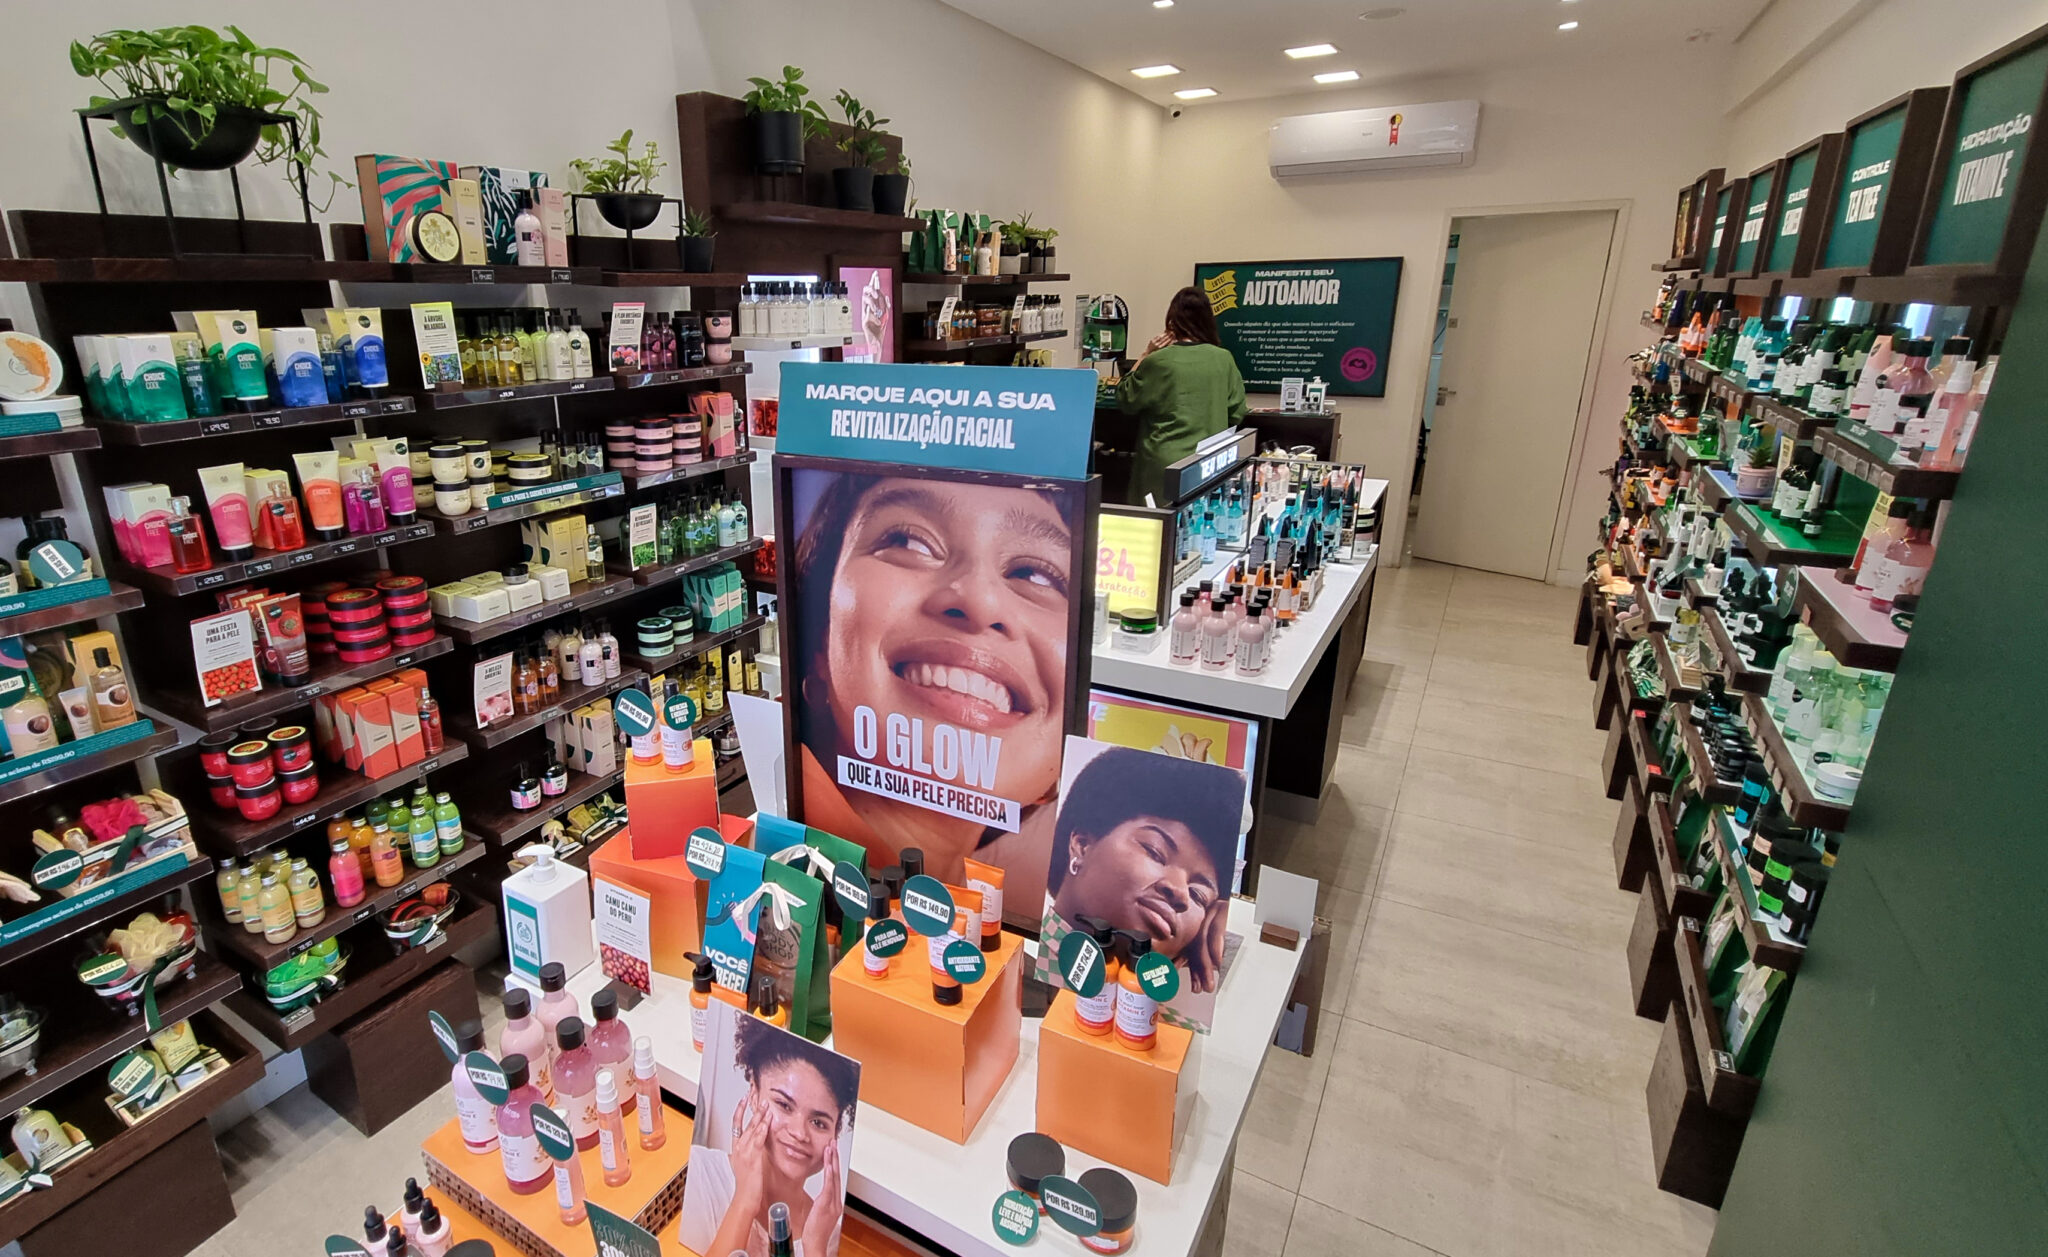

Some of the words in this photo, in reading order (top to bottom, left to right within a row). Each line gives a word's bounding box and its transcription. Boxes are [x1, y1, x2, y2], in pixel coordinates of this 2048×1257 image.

[1960, 113, 2032, 152] HIDRATAÇÃO
[1852, 160, 1892, 183] CONTROLE
[1243, 279, 1340, 306] AUTOAMOR
[144, 372, 165, 382] CHOICE
[805, 384, 904, 405] MARQUE
[908, 388, 970, 408] AQUI
[973, 390, 994, 408] A
[998, 392, 1056, 410] SUA
[831, 408, 952, 449] REVITALIZAÇÃO
[954, 416, 1015, 449] FACIAL
[144, 520, 165, 530] CHOICE
[206, 627, 220, 637] UMA
[220, 624, 238, 634] FESTA
[206, 634, 222, 644] PARA
[228, 629, 240, 639] PELE
[620, 700, 630, 711] POR
[854, 706, 877, 759] O
[886, 713, 1002, 790] GLOW
[848, 762, 872, 786] QUE
[874, 770, 882, 789] A
[884, 772, 910, 796] SUA
[912, 780, 944, 806] PELE
[948, 789, 1007, 824] PRECISA
[688, 849, 698, 860] POR
[36, 870, 49, 880] POR
[836, 880, 845, 892] POR
[845, 885, 851, 895] R$
[605, 894, 621, 910] CAMU
[621, 899, 637, 915] CAMU
[906, 893, 918, 906] POR
[919, 898, 927, 910] R$
[928, 900, 948, 918] 149,90
[609, 908, 617, 918] DO
[618, 911, 632, 924] PERU
[705, 945, 749, 974] VOCÊ
[1072, 974, 1081, 986] POR
[1046, 1192, 1060, 1206] POR
[1061, 1199, 1070, 1211] R$
[1071, 1203, 1095, 1221] 129,90
